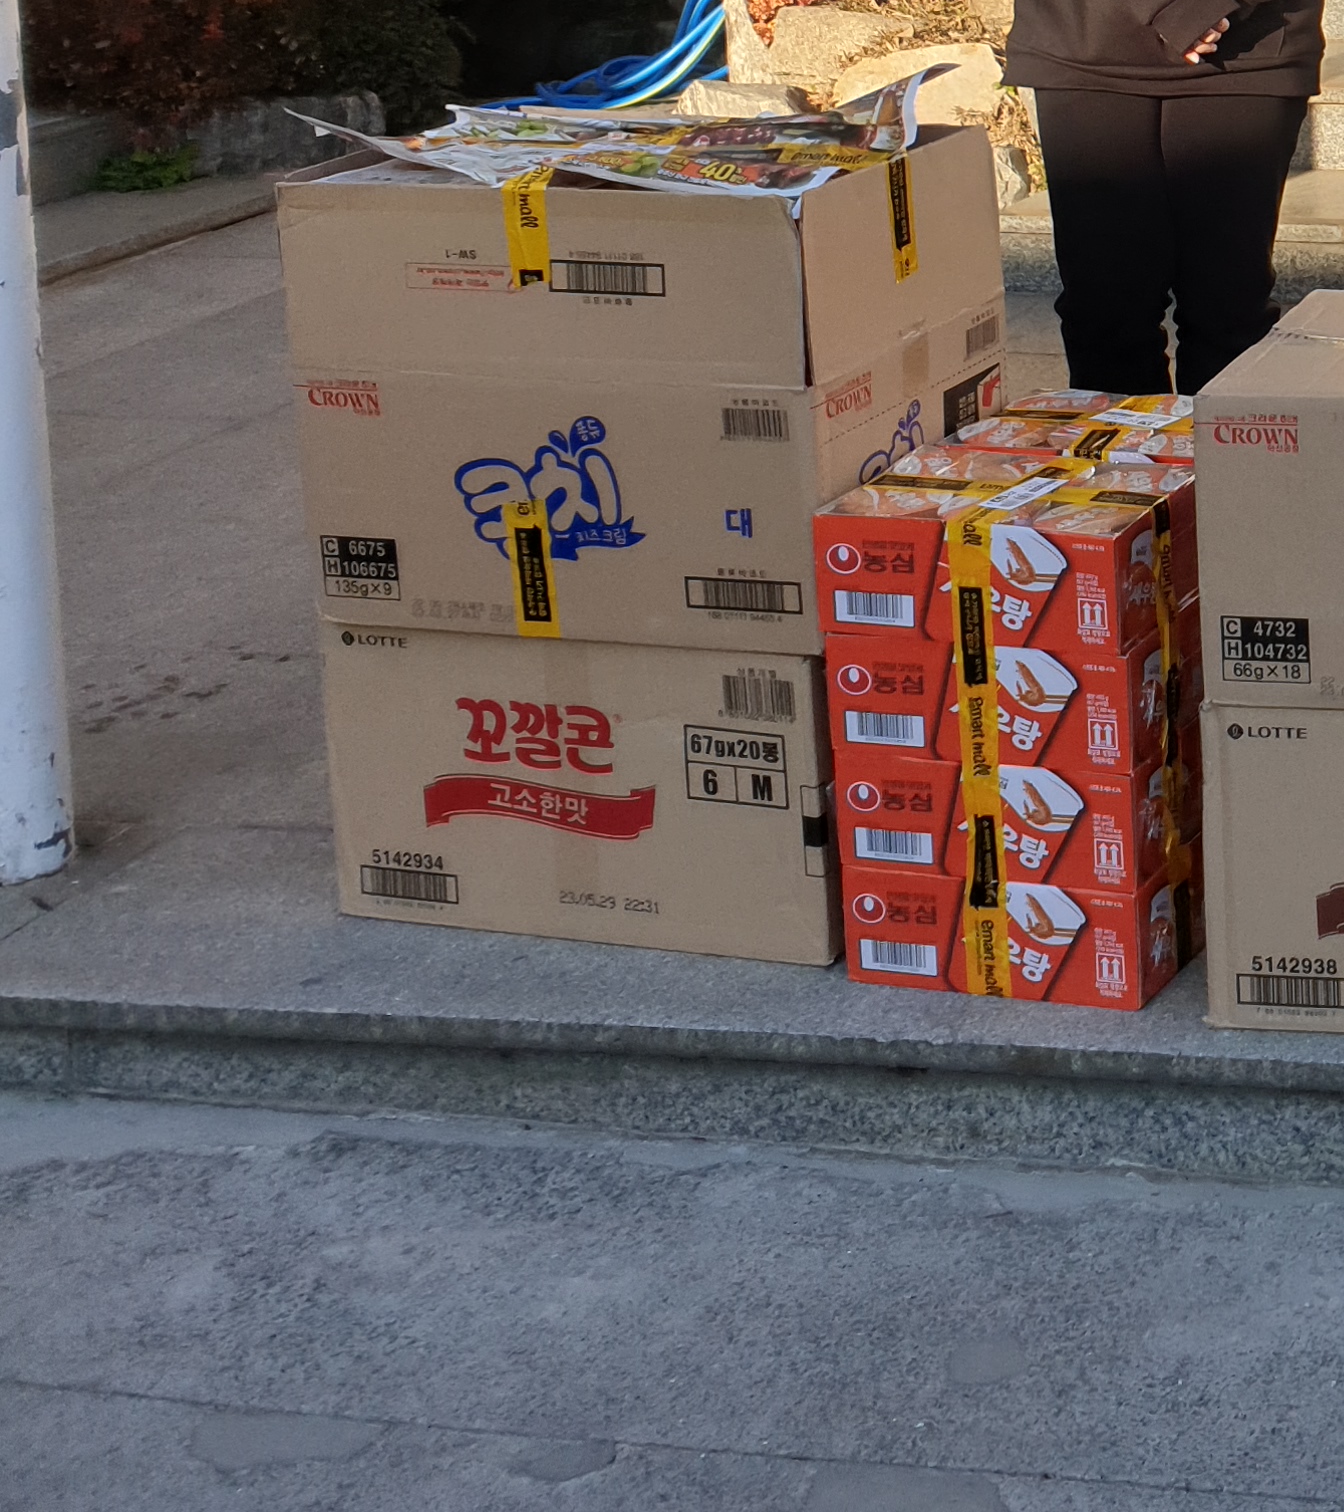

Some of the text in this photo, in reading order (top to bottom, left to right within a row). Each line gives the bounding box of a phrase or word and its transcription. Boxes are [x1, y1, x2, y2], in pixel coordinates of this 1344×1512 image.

[519, 192, 540, 229] mall
[307, 388, 381, 411] CROWN
[826, 384, 872, 419] CROWN
[1214, 424, 1298, 445] CROWN
[725, 508, 753, 538] 대
[349, 540, 386, 557] 6675
[342, 560, 397, 578] 106675
[863, 550, 915, 573] 농심
[1227, 619, 1296, 637] C 4732
[357, 634, 408, 648] LOTTE
[1244, 642, 1307, 660] 104732
[873, 672, 924, 695] 농심
[455, 697, 614, 775] 꼬깔콘
[1247, 726, 1307, 739] LOTTE
[973, 742, 992, 776] mall
[702, 769, 773, 802] 6 M
[488, 782, 588, 825] 고소한맛
[882, 790, 933, 813] 농심
[372, 849, 444, 870] 5142934
[887, 903, 937, 926] 농심
[981, 919, 995, 960] emart
[1251, 956, 1338, 975] 5142938
